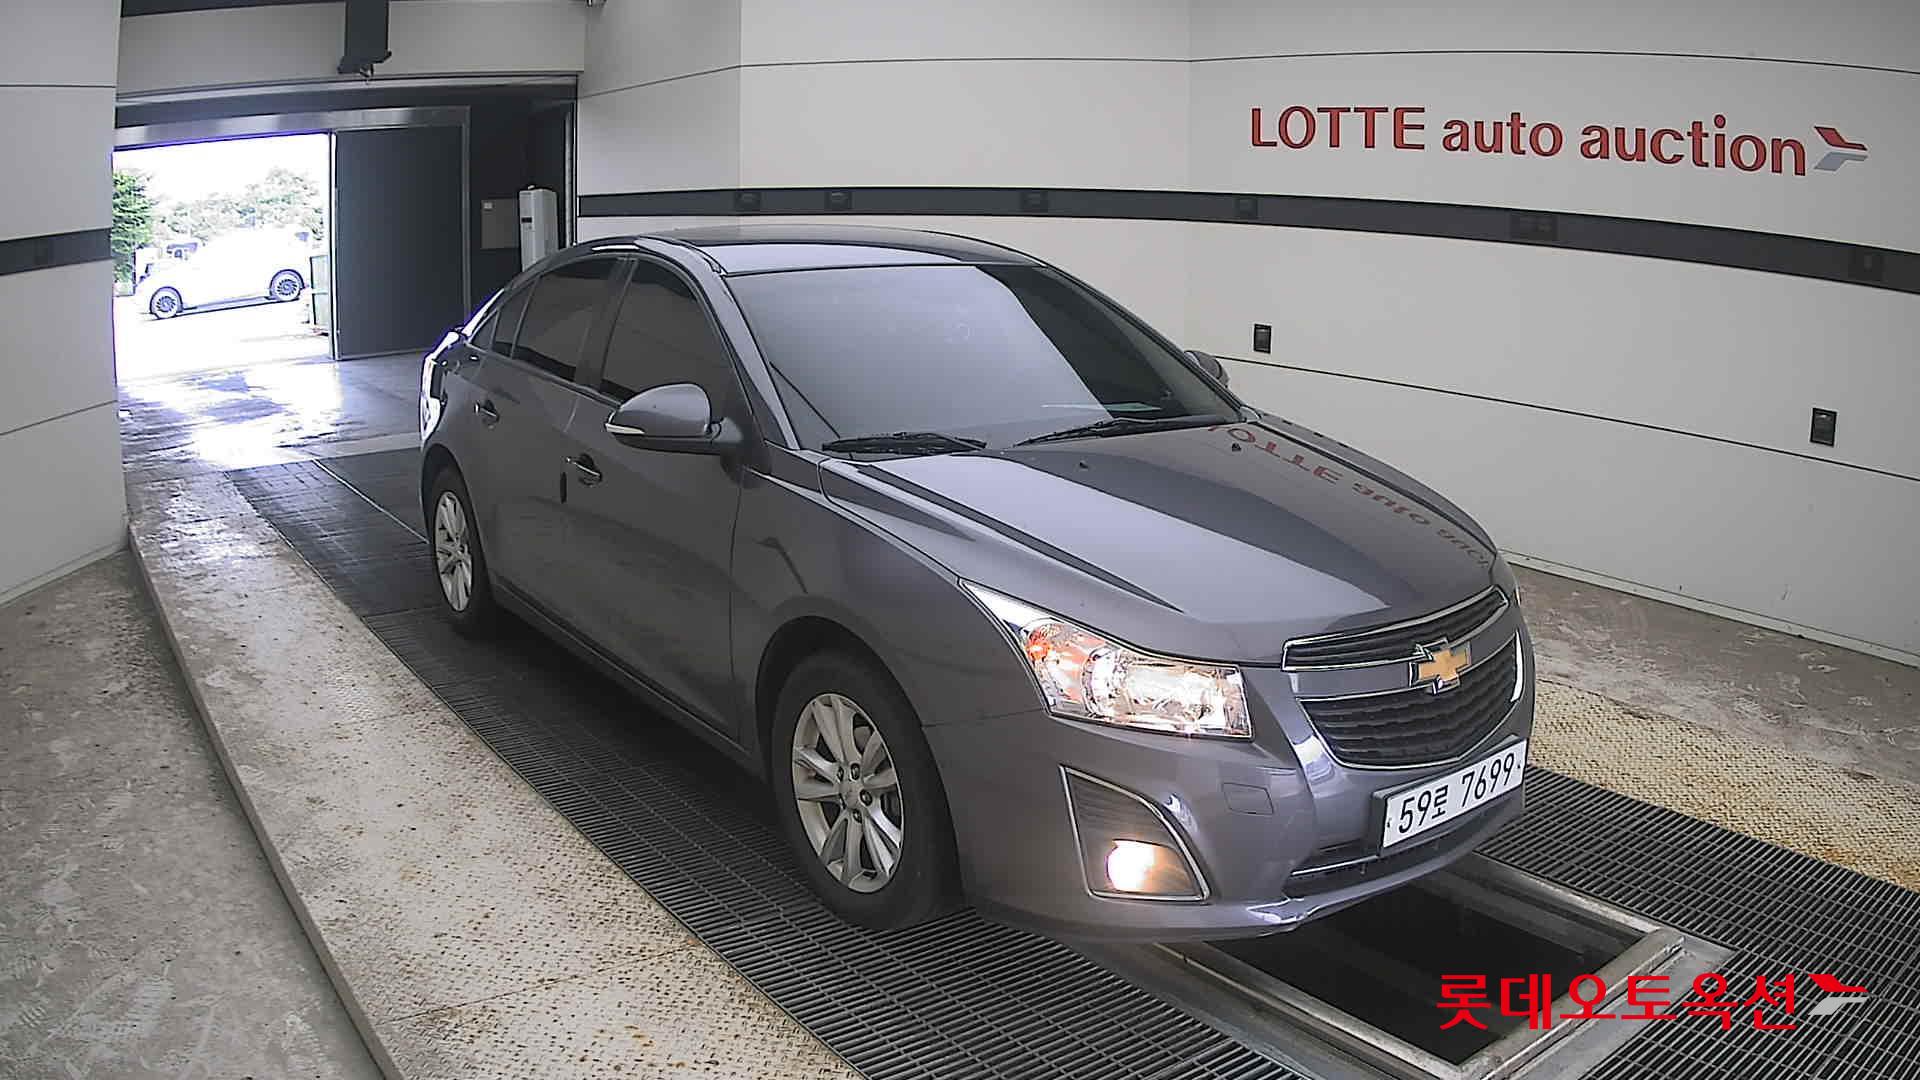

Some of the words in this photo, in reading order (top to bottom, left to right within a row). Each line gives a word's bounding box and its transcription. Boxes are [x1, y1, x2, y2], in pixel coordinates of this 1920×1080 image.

[1249, 105, 1426, 151] LOTTE
[1441, 111, 1564, 158] auto
[1578, 113, 1807, 177] auction
[1398, 784, 1449, 834] 59로
[1461, 753, 1515, 808] 7699
